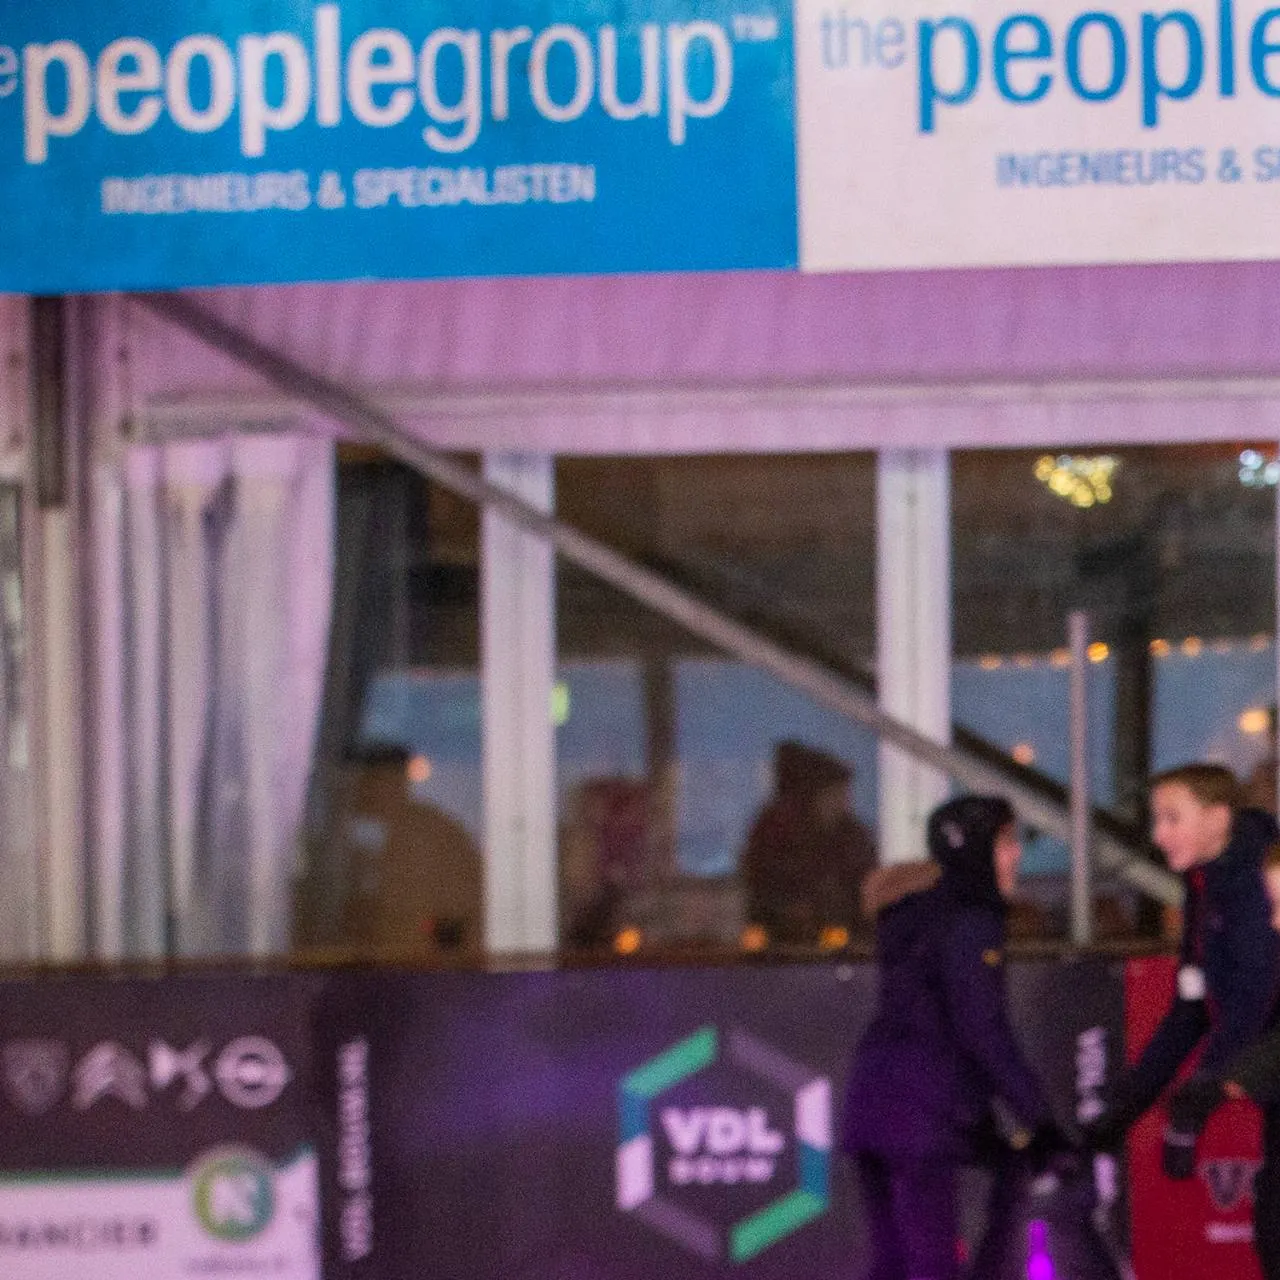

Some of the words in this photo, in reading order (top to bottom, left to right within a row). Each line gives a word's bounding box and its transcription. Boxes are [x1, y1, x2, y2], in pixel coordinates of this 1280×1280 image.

[101, 171, 310, 214] INGENIEURS
[317, 170, 345, 209] &
[353, 164, 597, 208] SPECIALISTEN
[997, 147, 1205, 188] INGENIEURS
[1217, 148, 1242, 183] &
[660, 1105, 785, 1154] VDL
